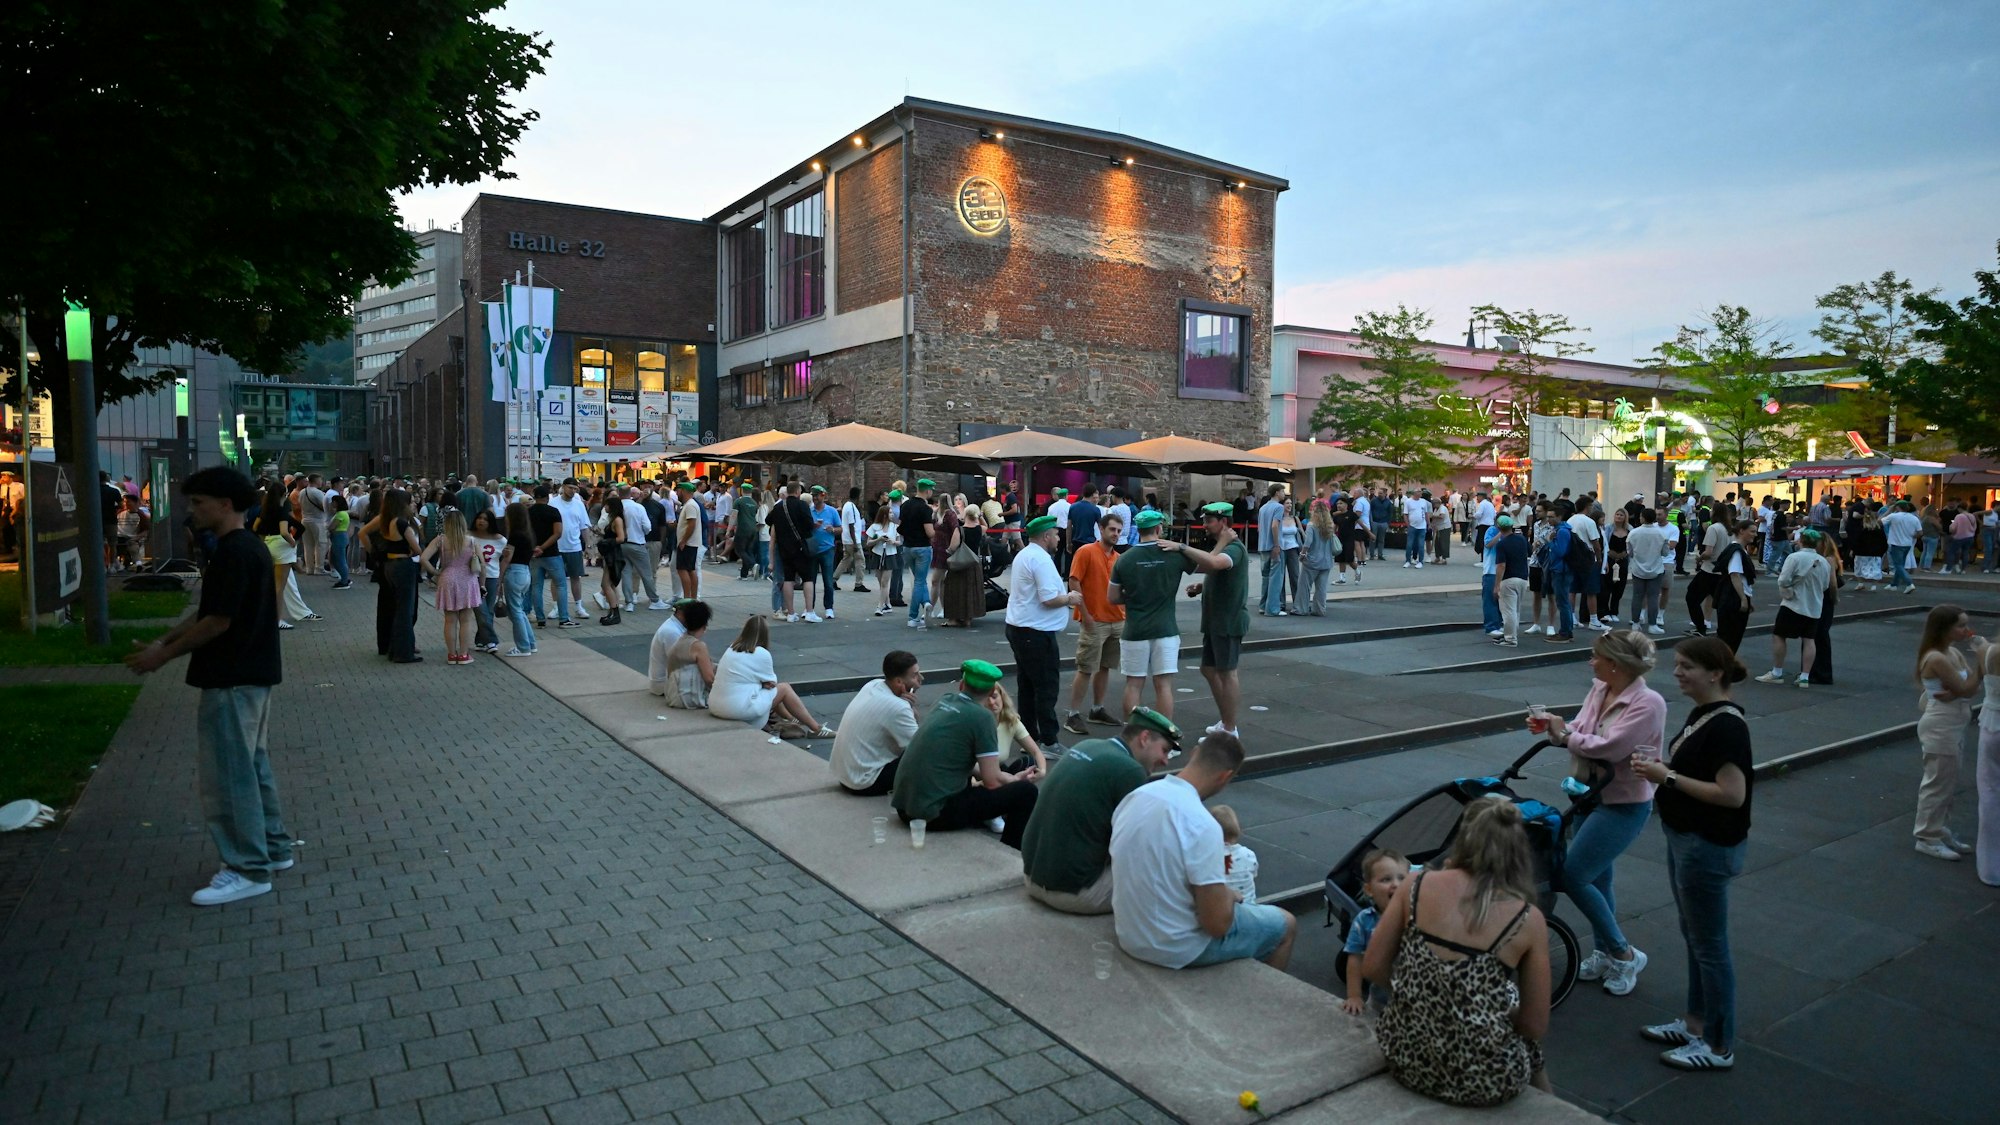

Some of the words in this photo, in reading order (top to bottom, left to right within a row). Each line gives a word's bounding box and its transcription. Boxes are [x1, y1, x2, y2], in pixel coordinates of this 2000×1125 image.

[964, 188, 1002, 208] 32
[508, 231, 570, 254] Halle
[579, 239, 606, 258] 32
[576, 402, 598, 410] swim
[590, 405, 603, 416] roll
